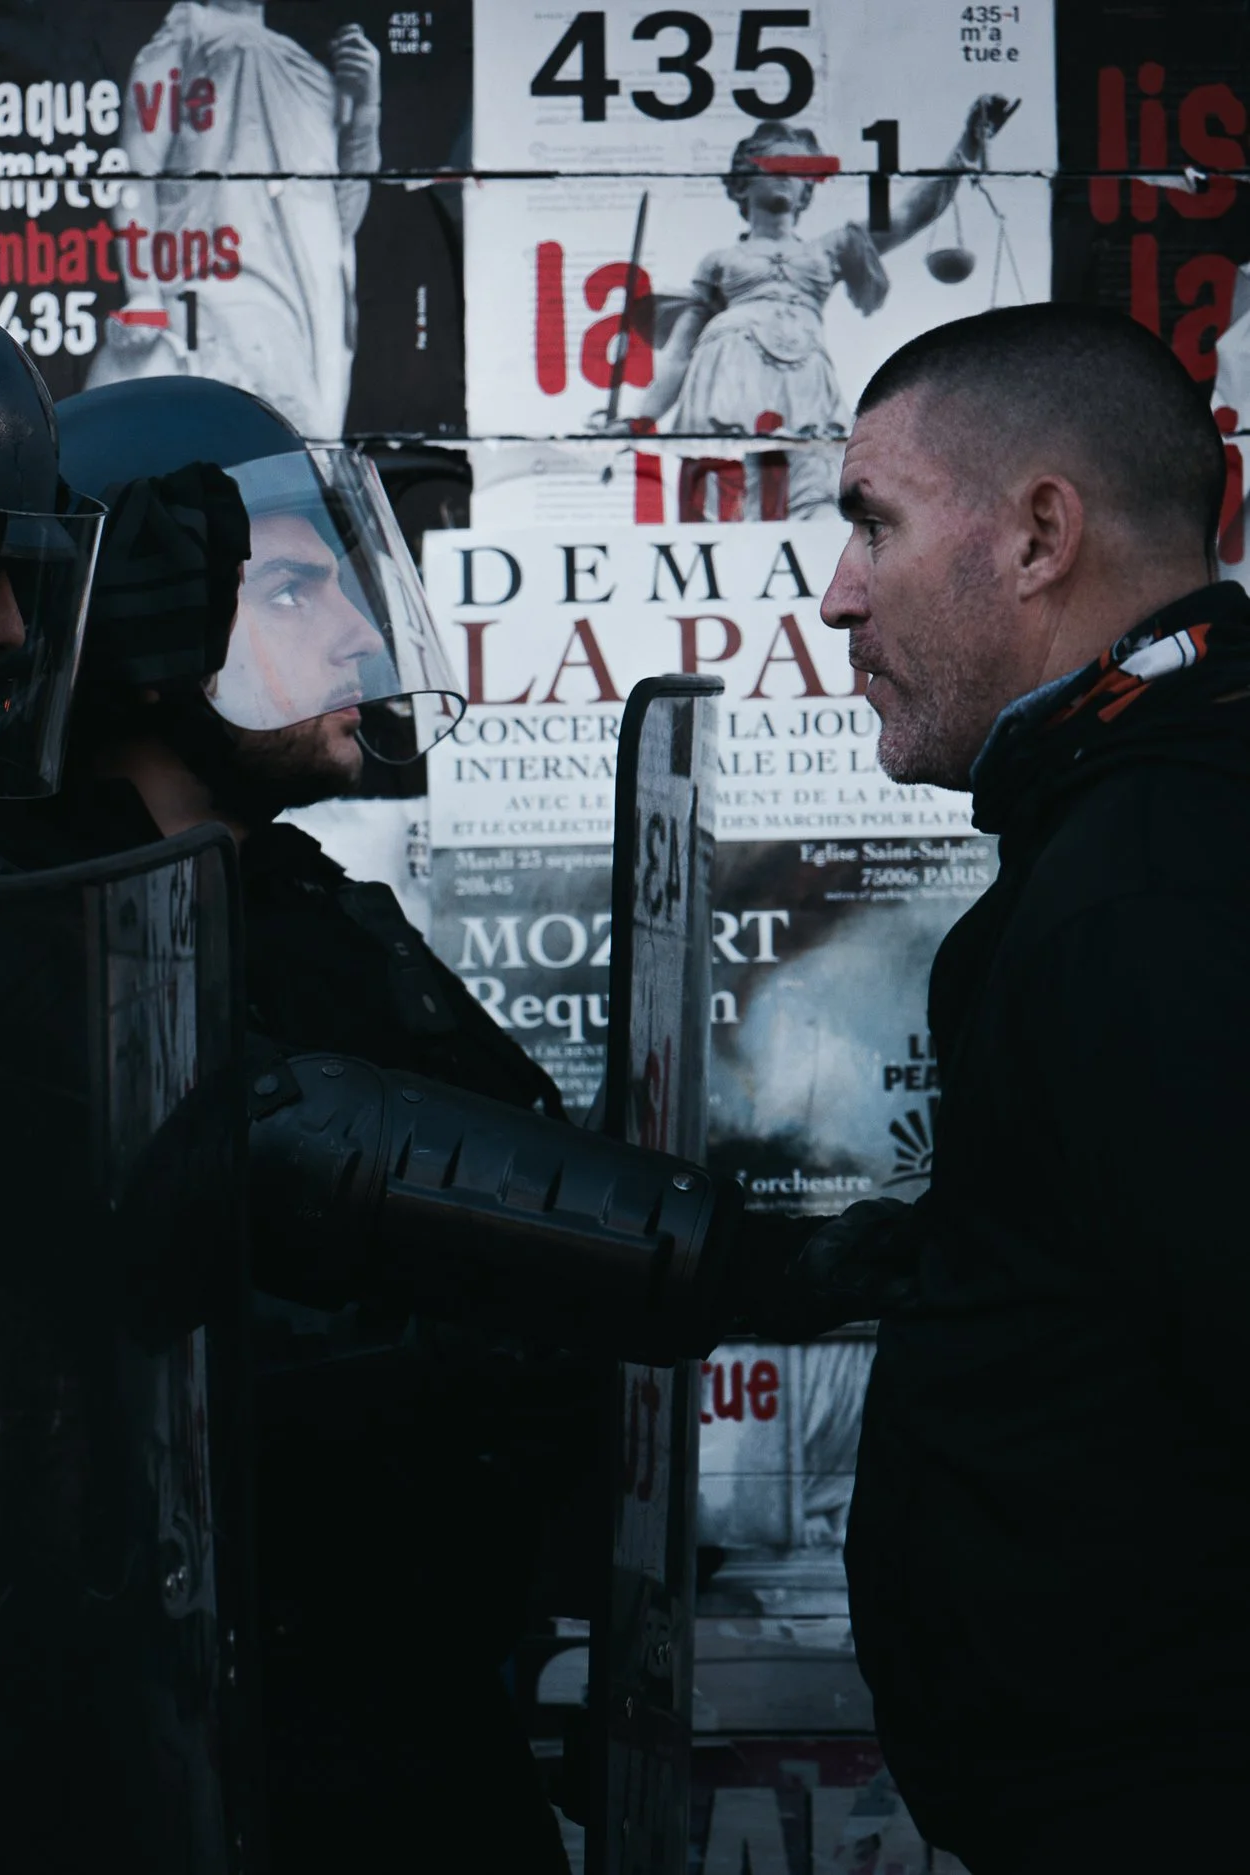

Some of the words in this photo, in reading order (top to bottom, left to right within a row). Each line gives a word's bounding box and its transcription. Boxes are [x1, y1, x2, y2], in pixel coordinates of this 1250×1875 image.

[531, 10, 814, 121] 435
[134, 68, 216, 133] vie
[537, 241, 654, 394] la
[458, 541, 817, 606] DEMA
[453, 618, 625, 705] LA
[452, 715, 620, 746] CONCER
[728, 711, 776, 738] LA
[789, 709, 874, 739] JOU
[788, 750, 838, 773] DE
[850, 750, 878, 772] L
[505, 795, 570, 812] AVEC
[794, 788, 827, 804] DE
[837, 787, 868, 803] LA
[879, 786, 936, 803] PAIX
[508, 818, 613, 835] COLLECTI
[860, 811, 915, 827] POUR
[918, 810, 942, 825] LA
[947, 809, 972, 824] PA
[801, 842, 857, 867] Eglise
[861, 840, 990, 864] Saint-Sulpice
[861, 866, 918, 887] 75006
[922, 865, 991, 885] PARIS
[751, 1168, 872, 1194] orchestre
